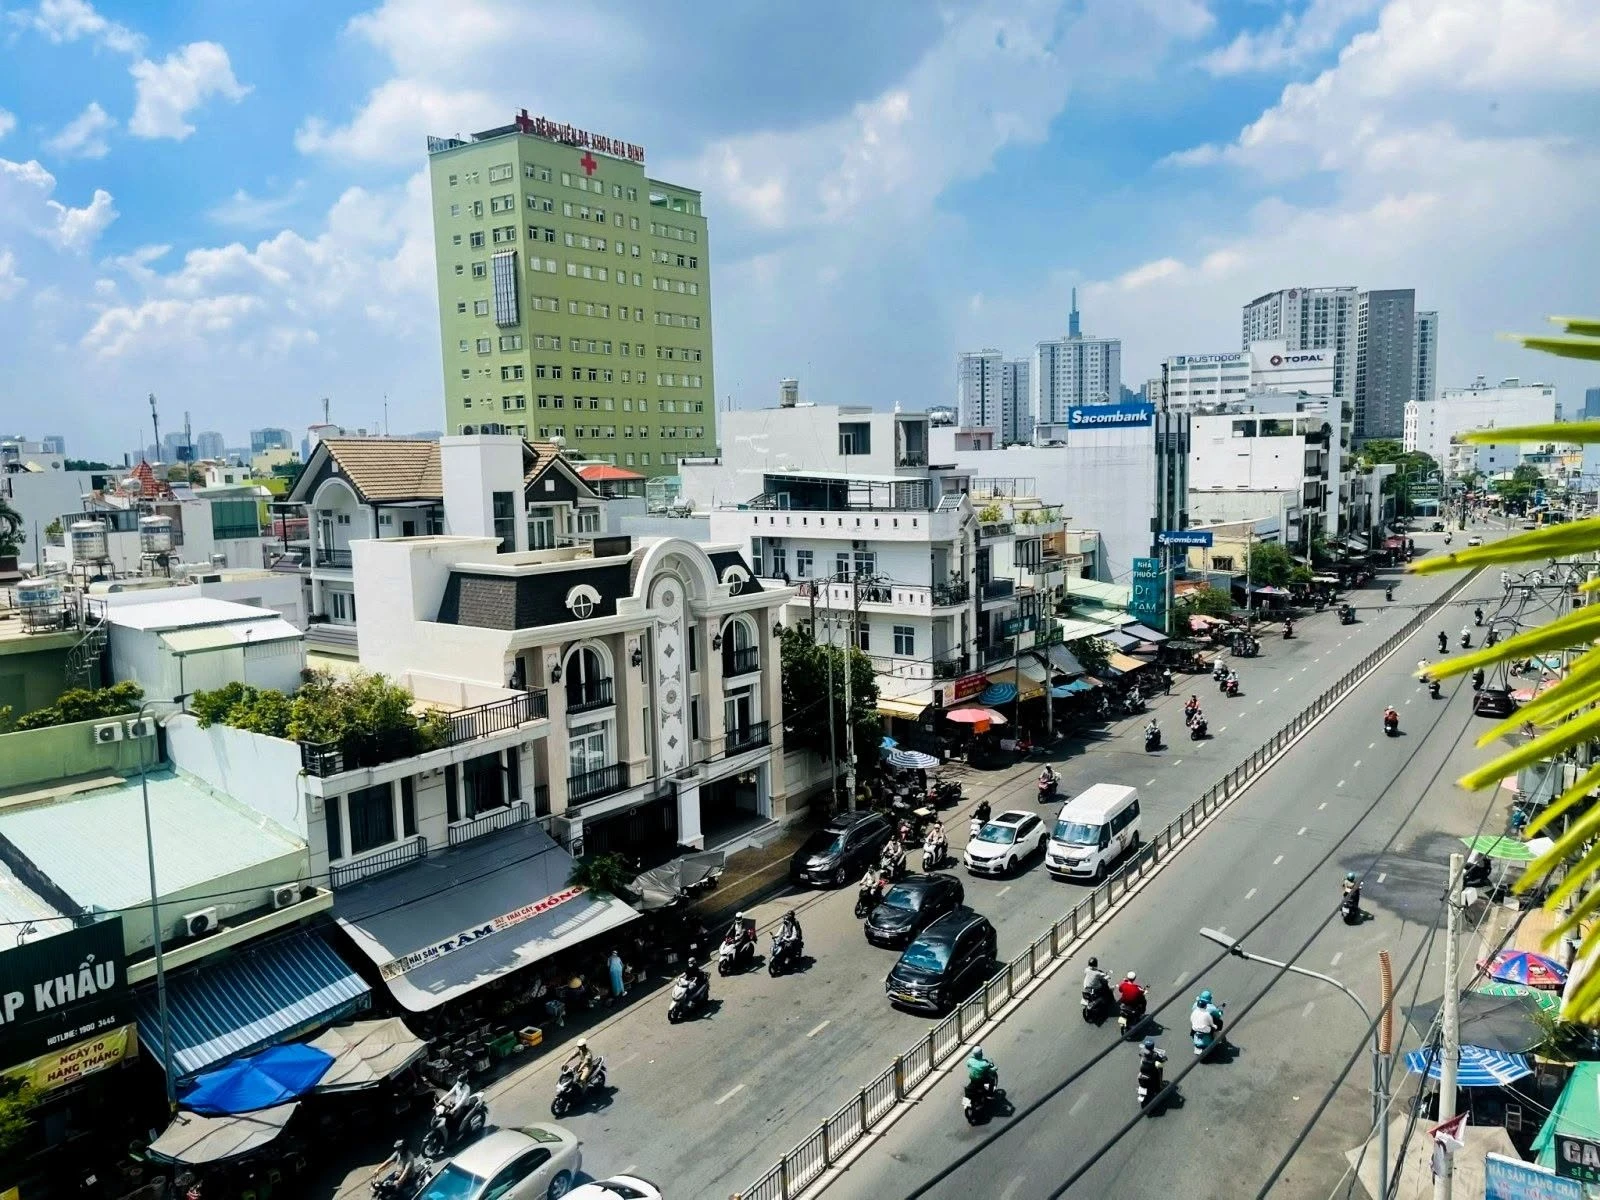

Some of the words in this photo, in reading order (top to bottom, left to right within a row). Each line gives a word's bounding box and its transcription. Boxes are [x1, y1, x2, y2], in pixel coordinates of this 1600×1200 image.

[592, 133, 612, 154] KHOA
[614, 139, 626, 157] GIA
[1187, 354, 1241, 364] AUSTDOOR
[1284, 354, 1324, 363] TOPAL
[1072, 409, 1148, 424] Sacombank
[408, 953, 422, 964] HẢI
[422, 946, 438, 958] SẢN
[438, 924, 494, 952] TÂM
[534, 885, 584, 913] HỒNG
[34, 954, 116, 1012] KHẨU
[47, 1029, 78, 1046] HOTLINE:
[79, 1022, 95, 1034] 1900
[47, 1064, 80, 1082] HÀNG
[82, 1048, 120, 1068] THÁNG
[60, 1046, 90, 1066] NGÀY
[93, 1042, 105, 1052] 10
